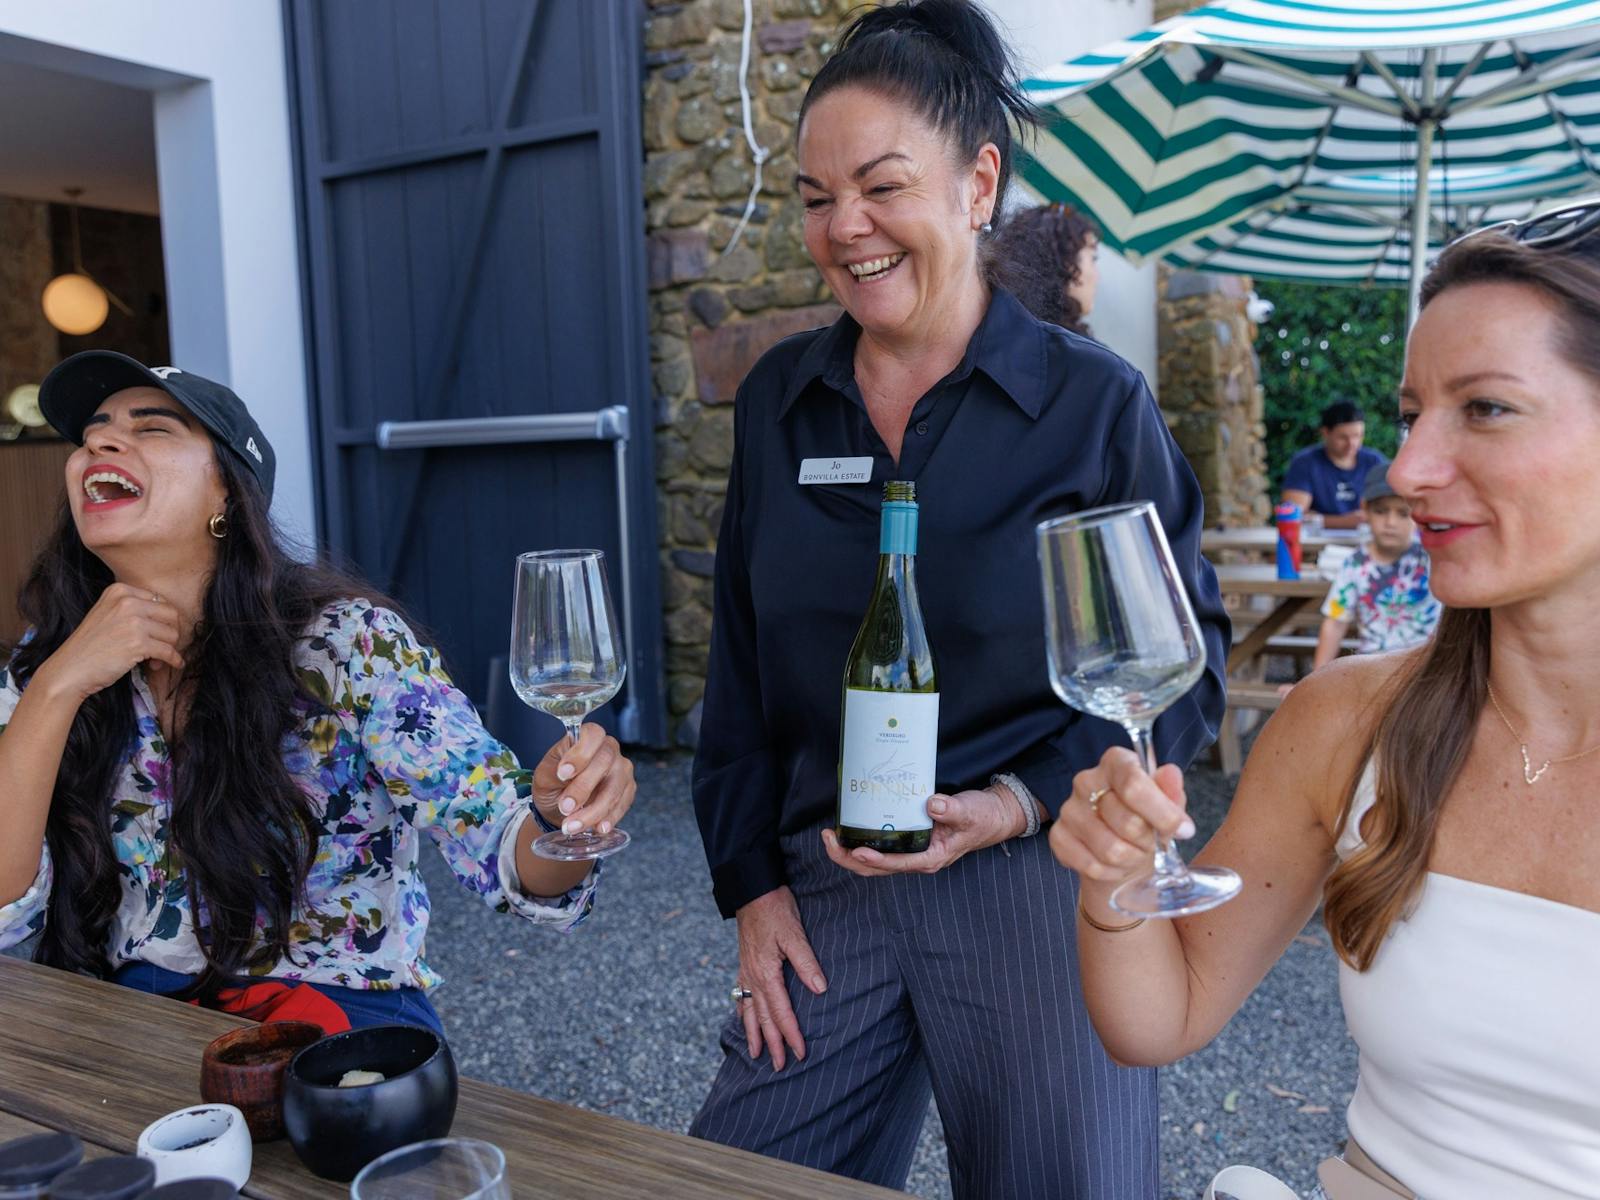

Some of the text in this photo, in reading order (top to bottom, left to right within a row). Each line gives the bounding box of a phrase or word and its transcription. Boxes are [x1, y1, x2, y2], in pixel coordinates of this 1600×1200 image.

[831, 461, 841, 470] Jo
[803, 472, 865, 481] BONVILLA ESTATE
[850, 779, 927, 797] BOILLA
